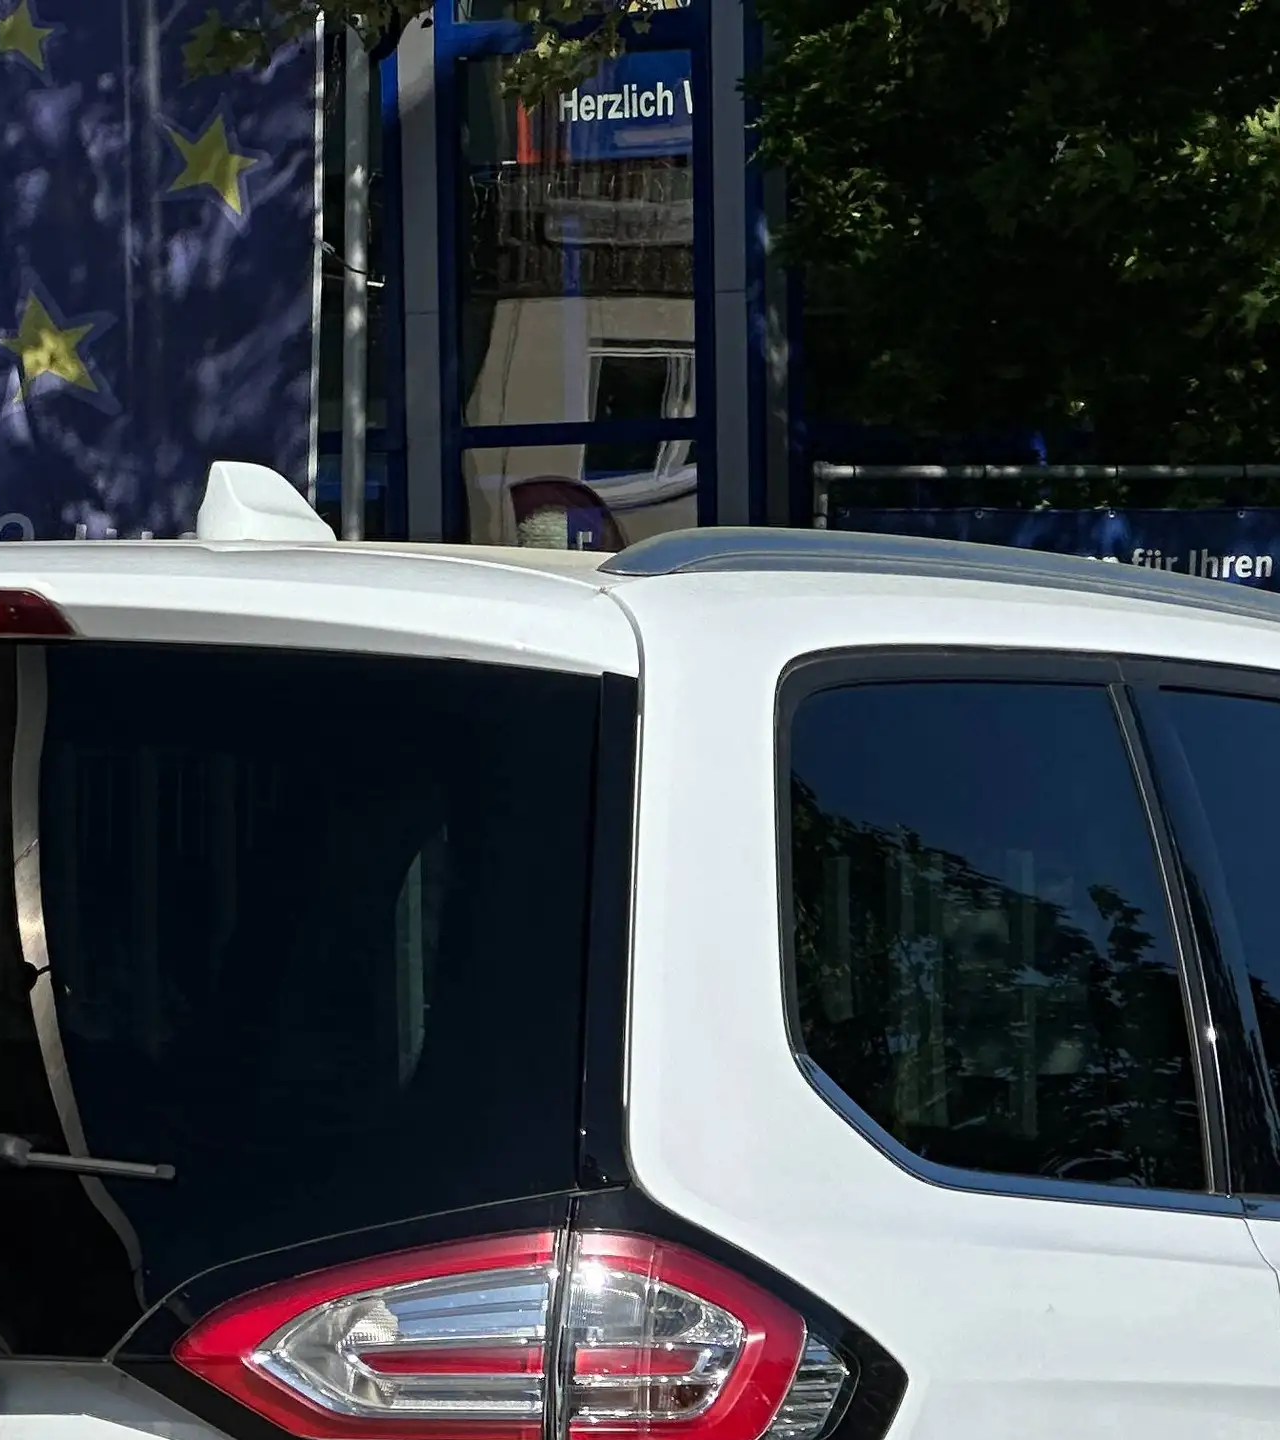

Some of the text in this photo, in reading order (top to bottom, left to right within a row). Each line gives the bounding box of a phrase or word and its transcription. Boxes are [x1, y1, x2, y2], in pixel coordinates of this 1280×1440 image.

[558, 81, 673, 122] Herzlich
[1132, 547, 1273, 578] für Ihren
